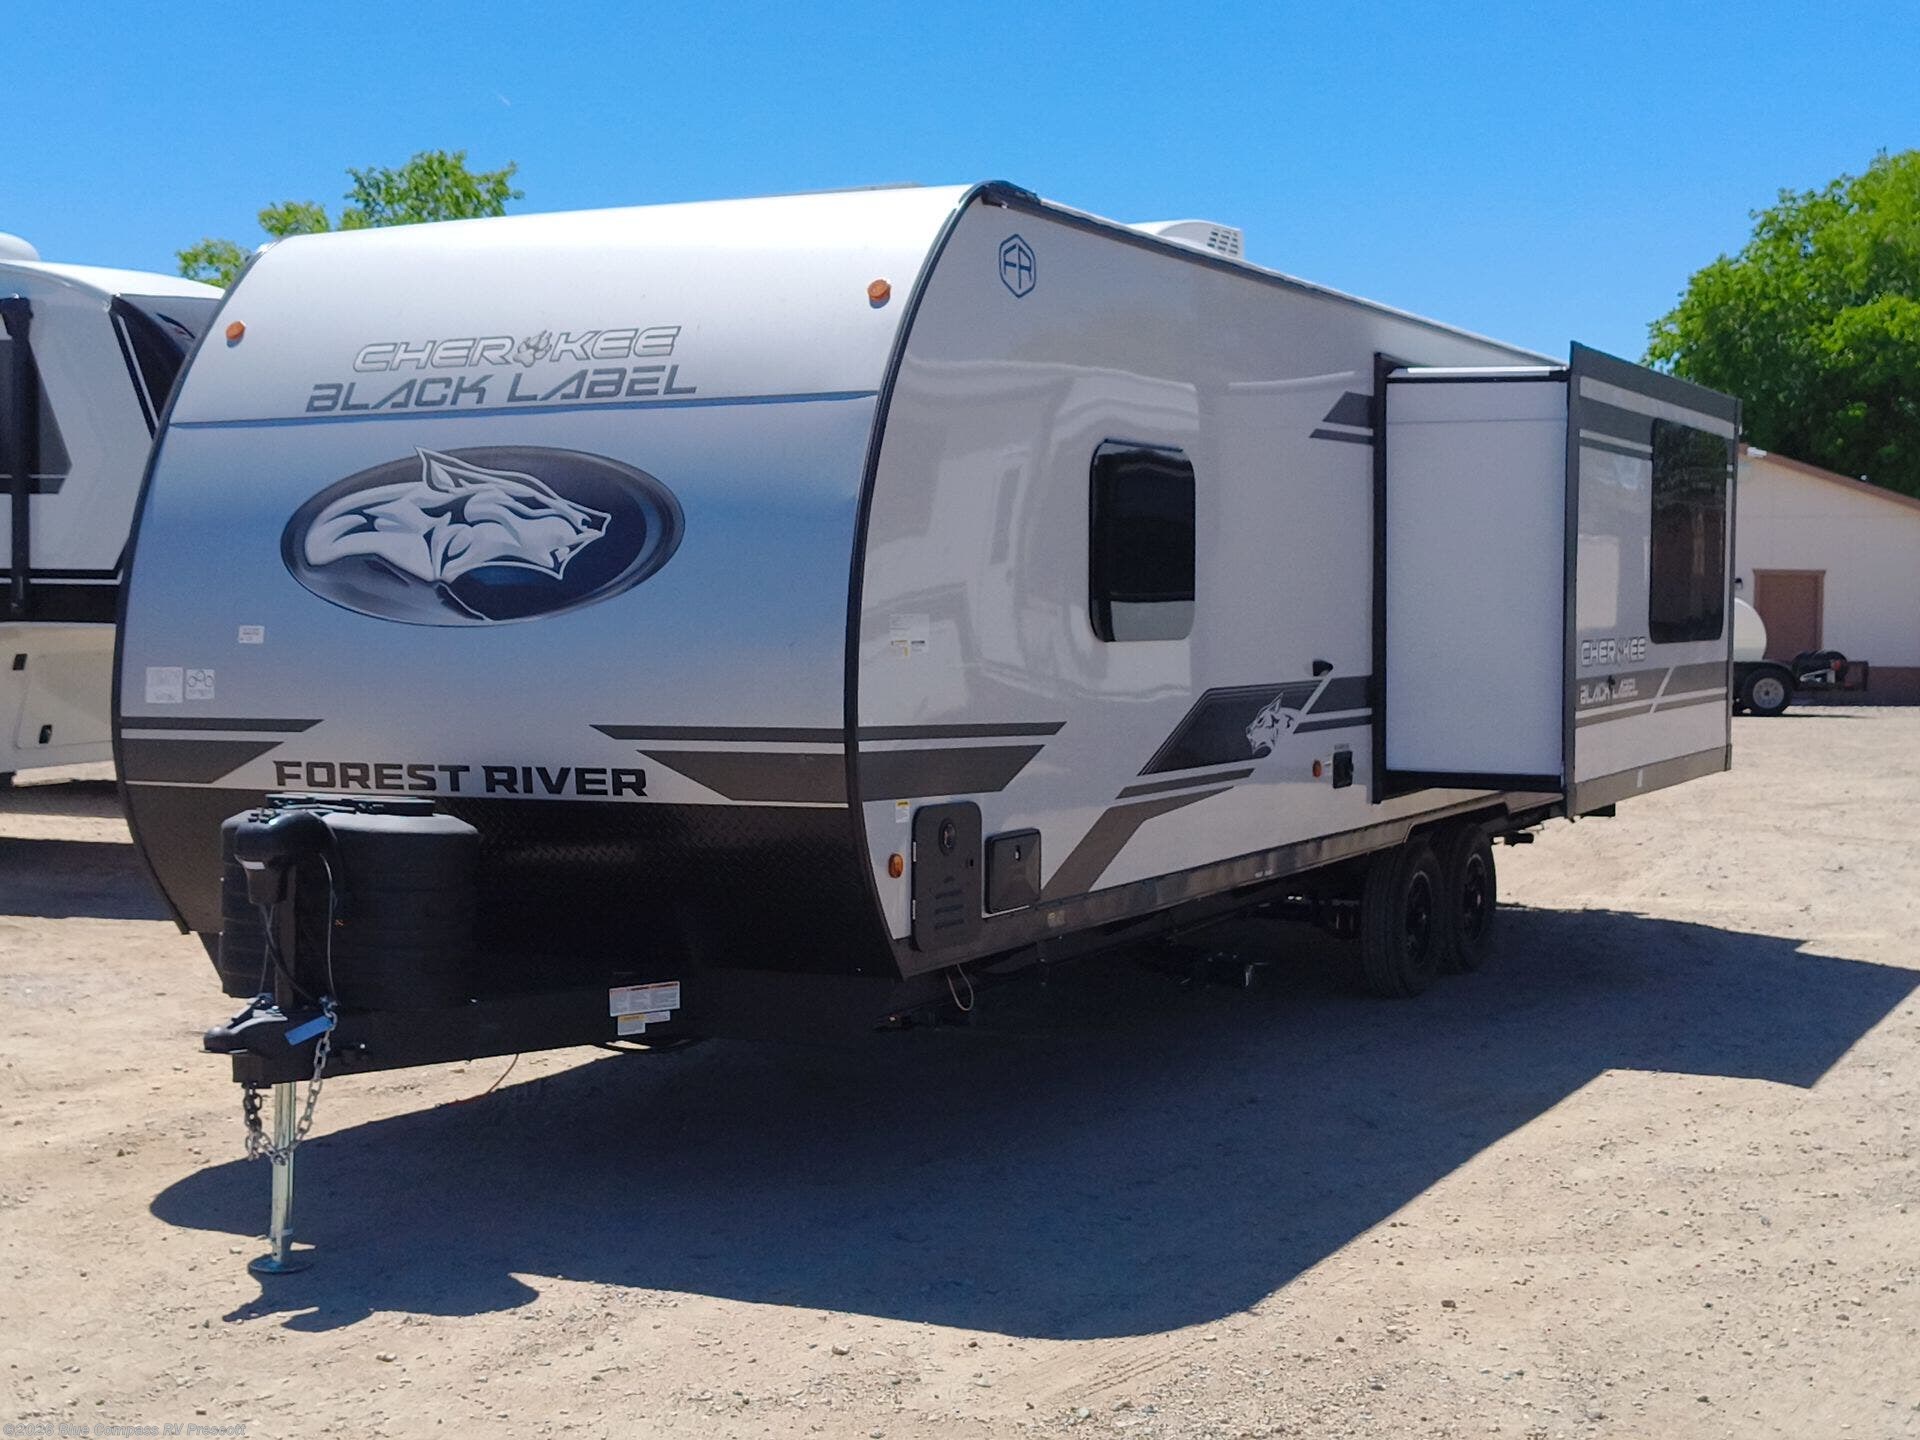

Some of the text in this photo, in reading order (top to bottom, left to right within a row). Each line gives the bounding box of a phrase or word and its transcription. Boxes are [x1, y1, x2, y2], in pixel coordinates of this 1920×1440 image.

[305, 364, 698, 413] BLACK LABEL
[273, 760, 649, 797] FOREST RIVER
